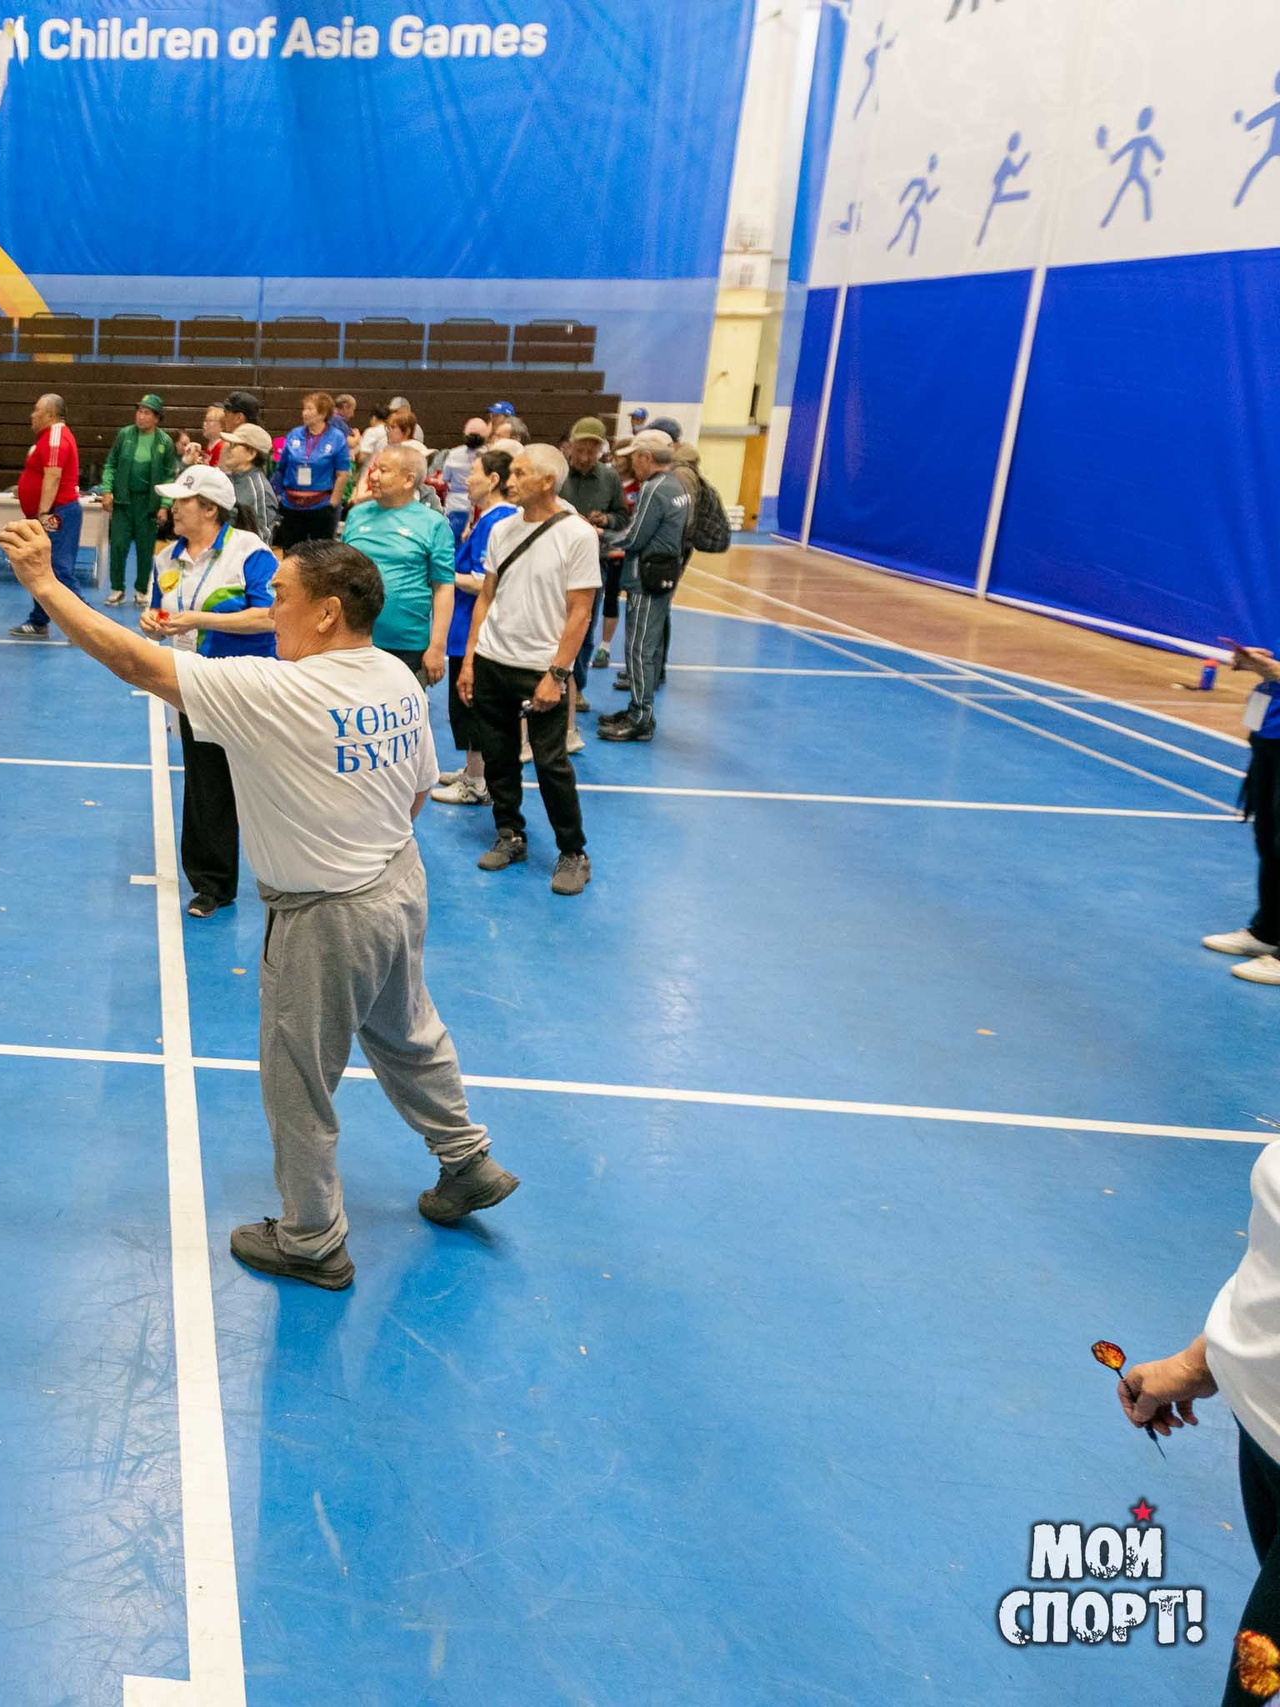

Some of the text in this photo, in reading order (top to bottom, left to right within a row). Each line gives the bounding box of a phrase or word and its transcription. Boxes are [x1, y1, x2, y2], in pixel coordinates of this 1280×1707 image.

[39, 17, 218, 60] Children
[228, 16, 277, 59] of
[280, 16, 379, 59] Asia
[389, 15, 548, 58] Games
